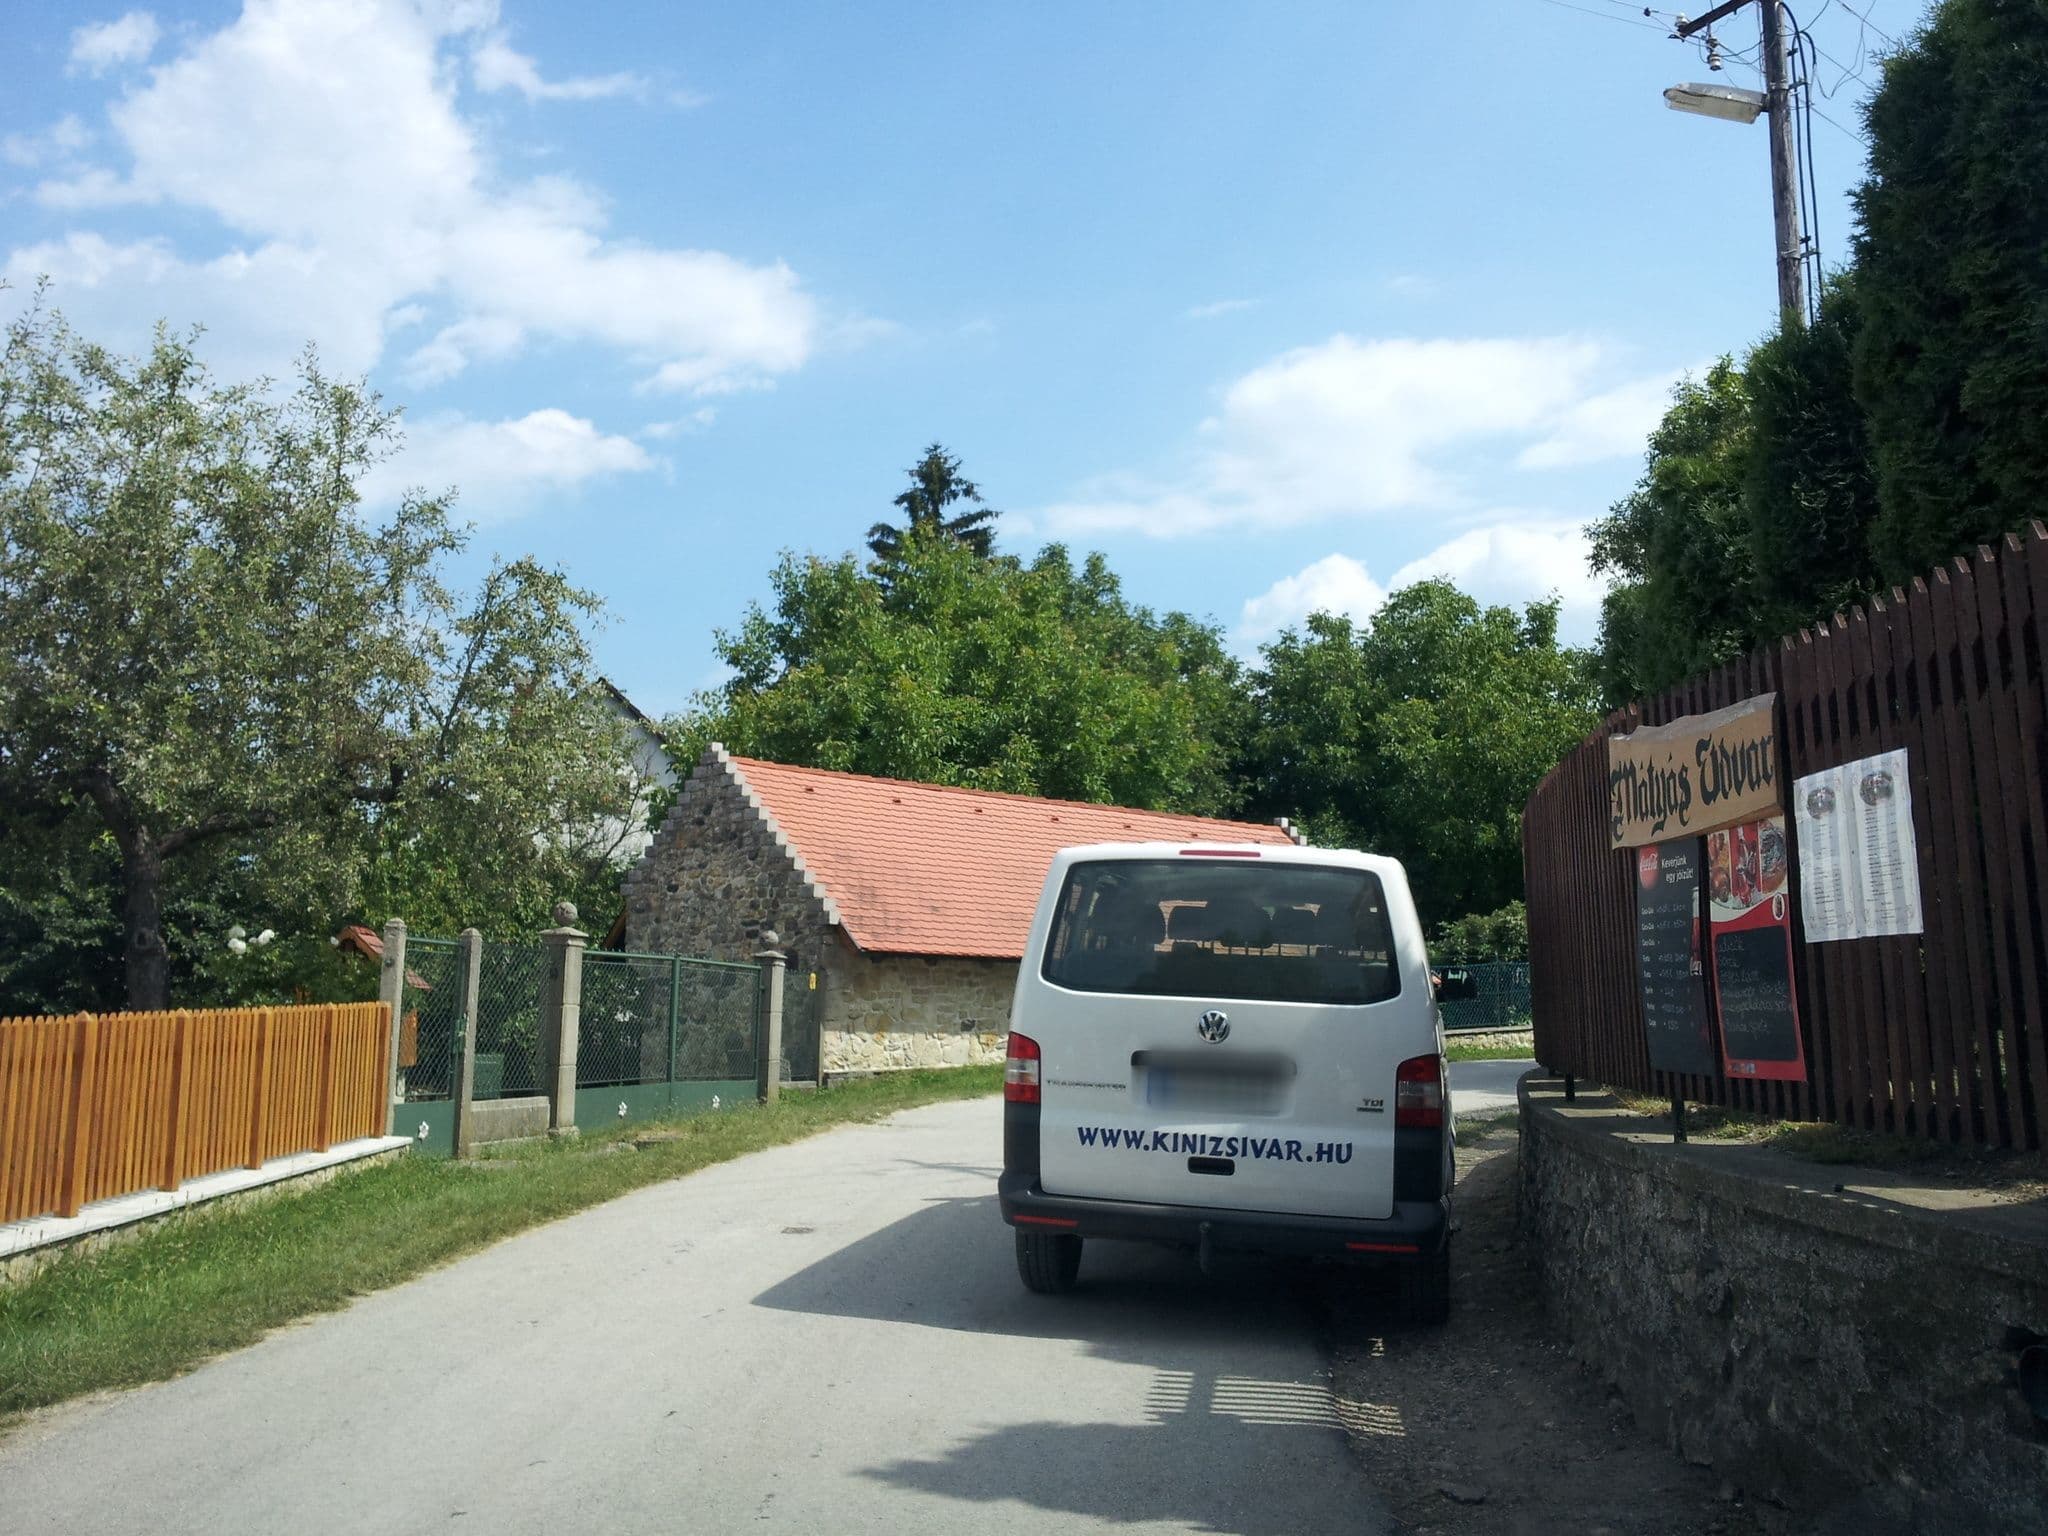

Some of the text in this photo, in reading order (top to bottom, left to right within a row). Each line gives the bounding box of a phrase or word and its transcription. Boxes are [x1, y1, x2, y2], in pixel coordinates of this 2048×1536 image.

[1610, 733, 1774, 842] Mátyás Udvar
[1362, 1098, 1384, 1107] TDI
[1077, 1126, 1353, 1165] WWW.KINIZSIVAR.HU
